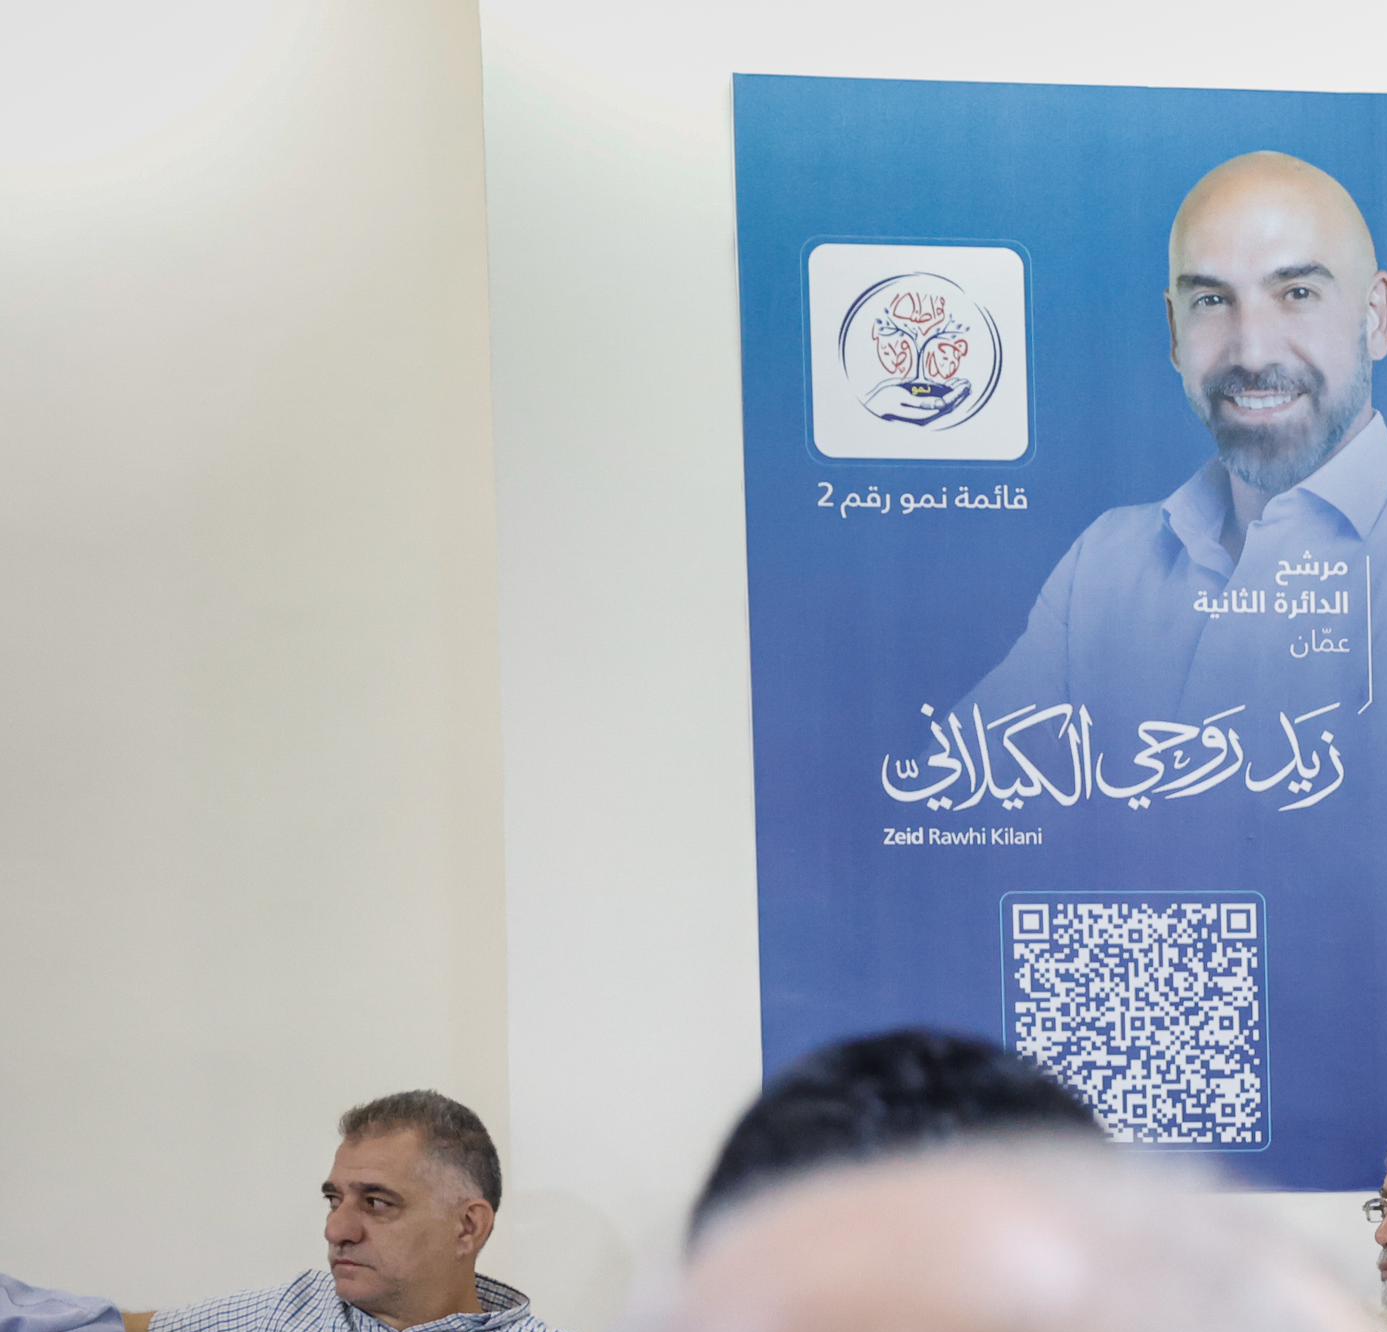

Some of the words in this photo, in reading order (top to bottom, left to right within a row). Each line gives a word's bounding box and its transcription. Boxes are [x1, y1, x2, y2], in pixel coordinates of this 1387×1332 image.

[817, 481, 834, 507] 2
[840, 485, 891, 519] رقم
[899, 486, 947, 515] نمو
[954, 484, 1028, 510] قائمة
[1274, 549, 1349, 587] مرشح
[1193, 587, 1266, 619] الثانية
[1274, 590, 1349, 619] الدائرة
[883, 826, 924, 846] Zeid
[928, 827, 986, 846] Rawhi
[991, 827, 1043, 846] Kilani
